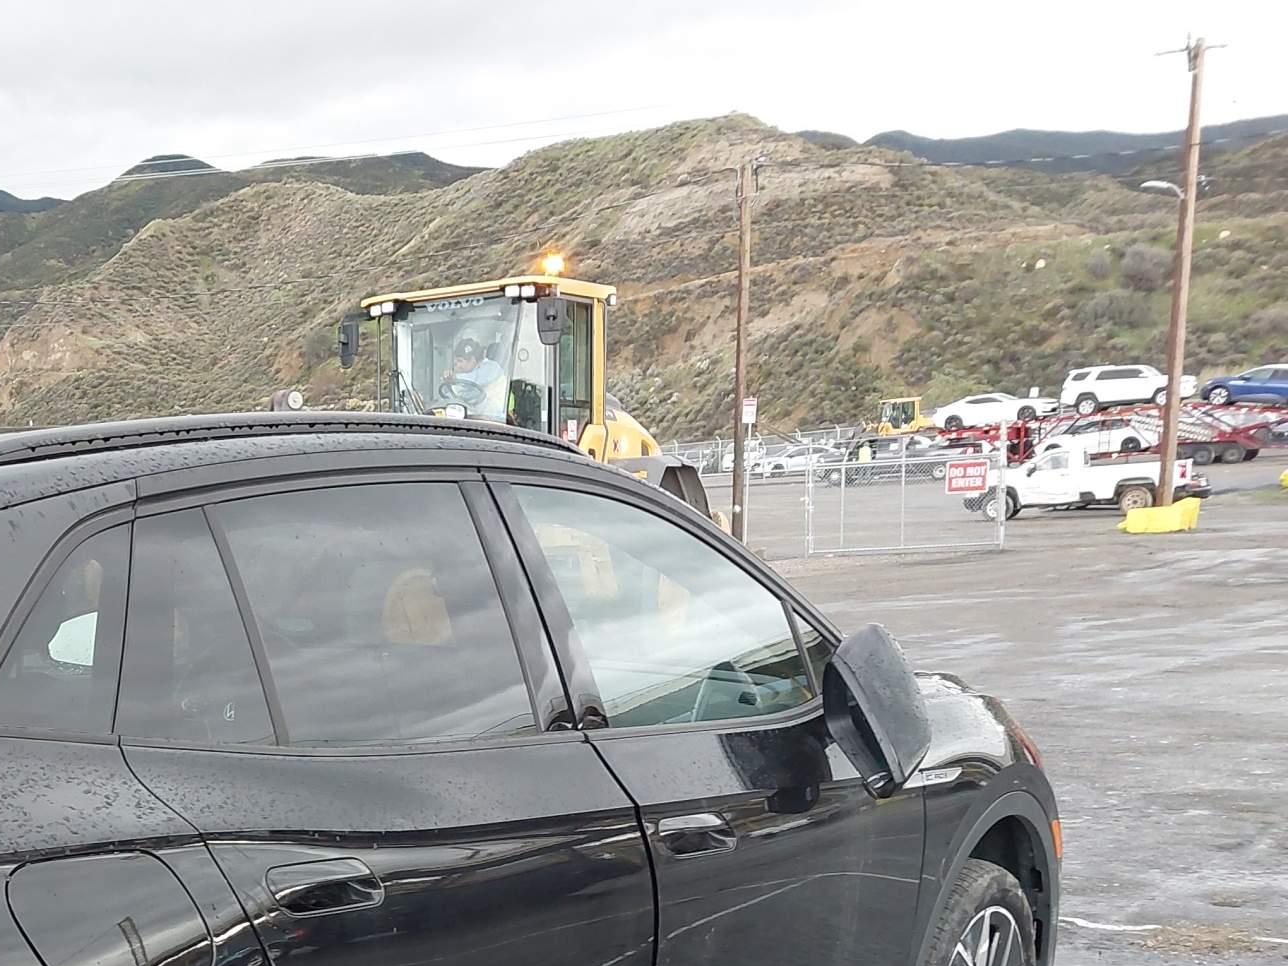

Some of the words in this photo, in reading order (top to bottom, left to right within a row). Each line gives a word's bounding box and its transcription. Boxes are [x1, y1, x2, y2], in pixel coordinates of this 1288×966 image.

[426, 297, 484, 312] VOLVO
[949, 467, 964, 477] DO
[966, 466, 986, 476] NOT
[951, 477, 983, 488] ENTER
